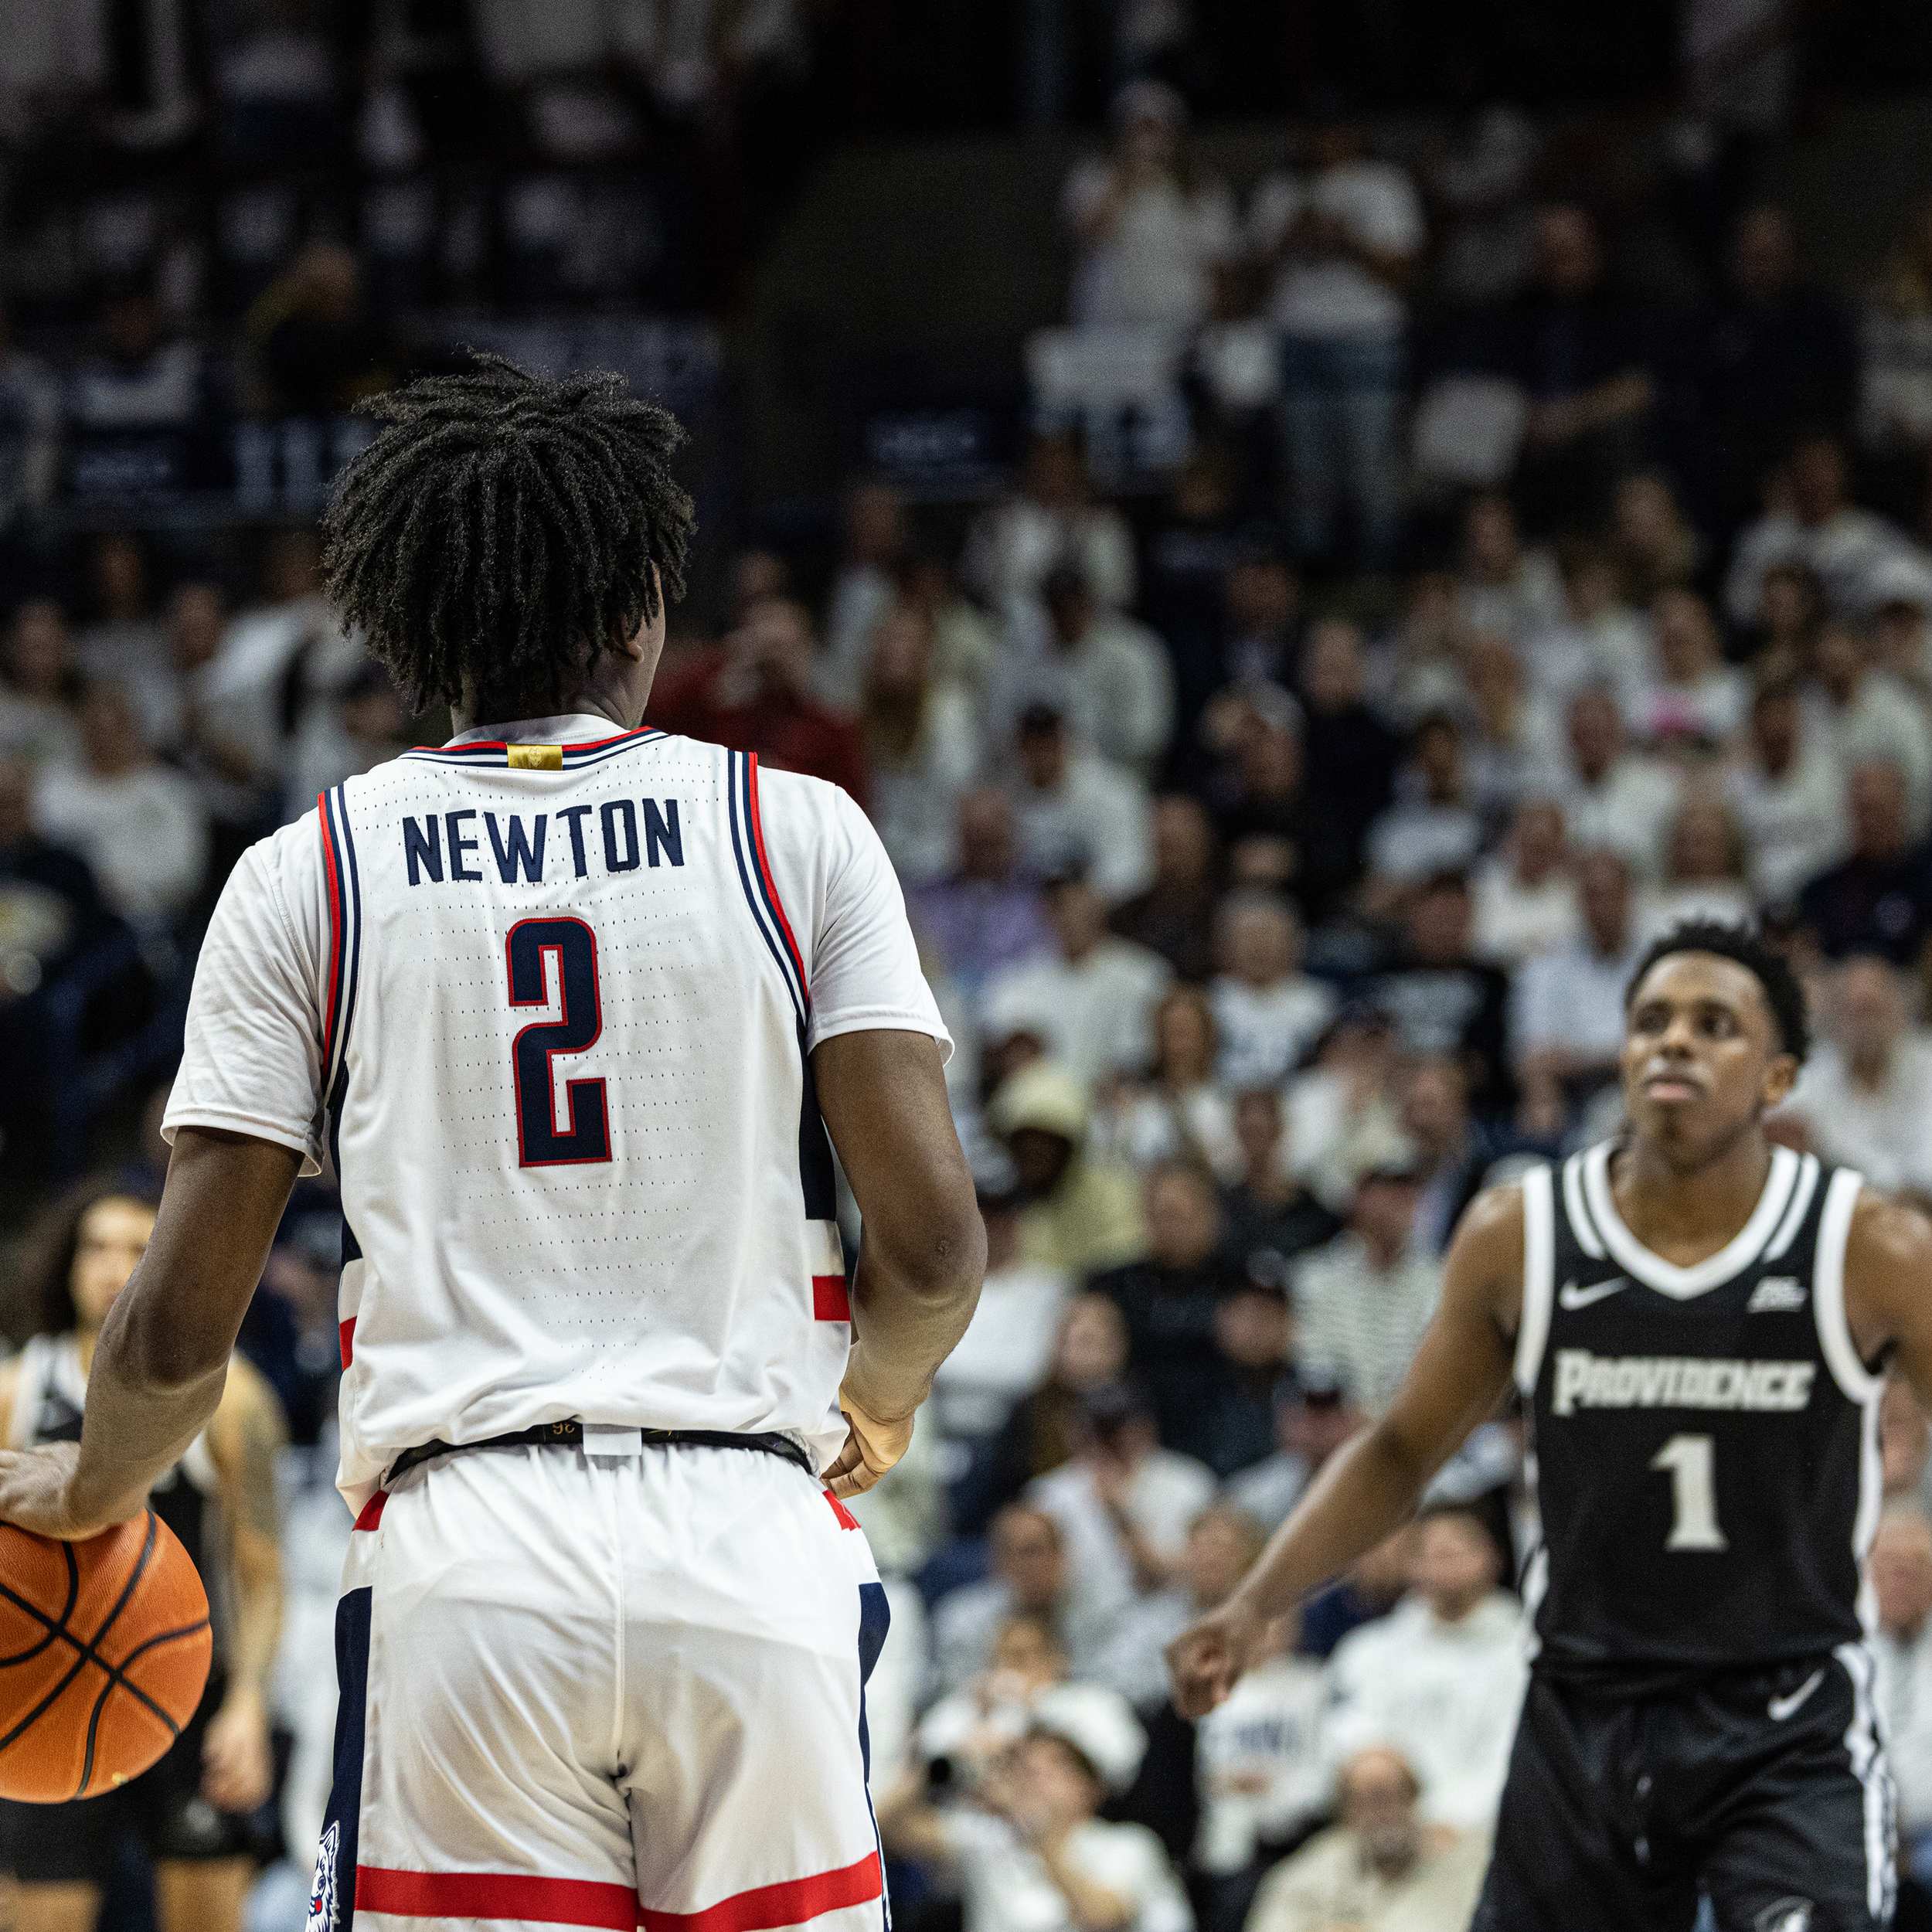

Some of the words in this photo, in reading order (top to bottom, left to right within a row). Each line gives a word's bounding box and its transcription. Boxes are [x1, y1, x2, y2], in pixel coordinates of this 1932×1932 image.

[403, 798, 685, 886] NEWTON
[505, 917, 613, 1168] 2
[1553, 1349, 1815, 1416] PROVIDENCE
[1651, 1433, 1728, 1550] 1
